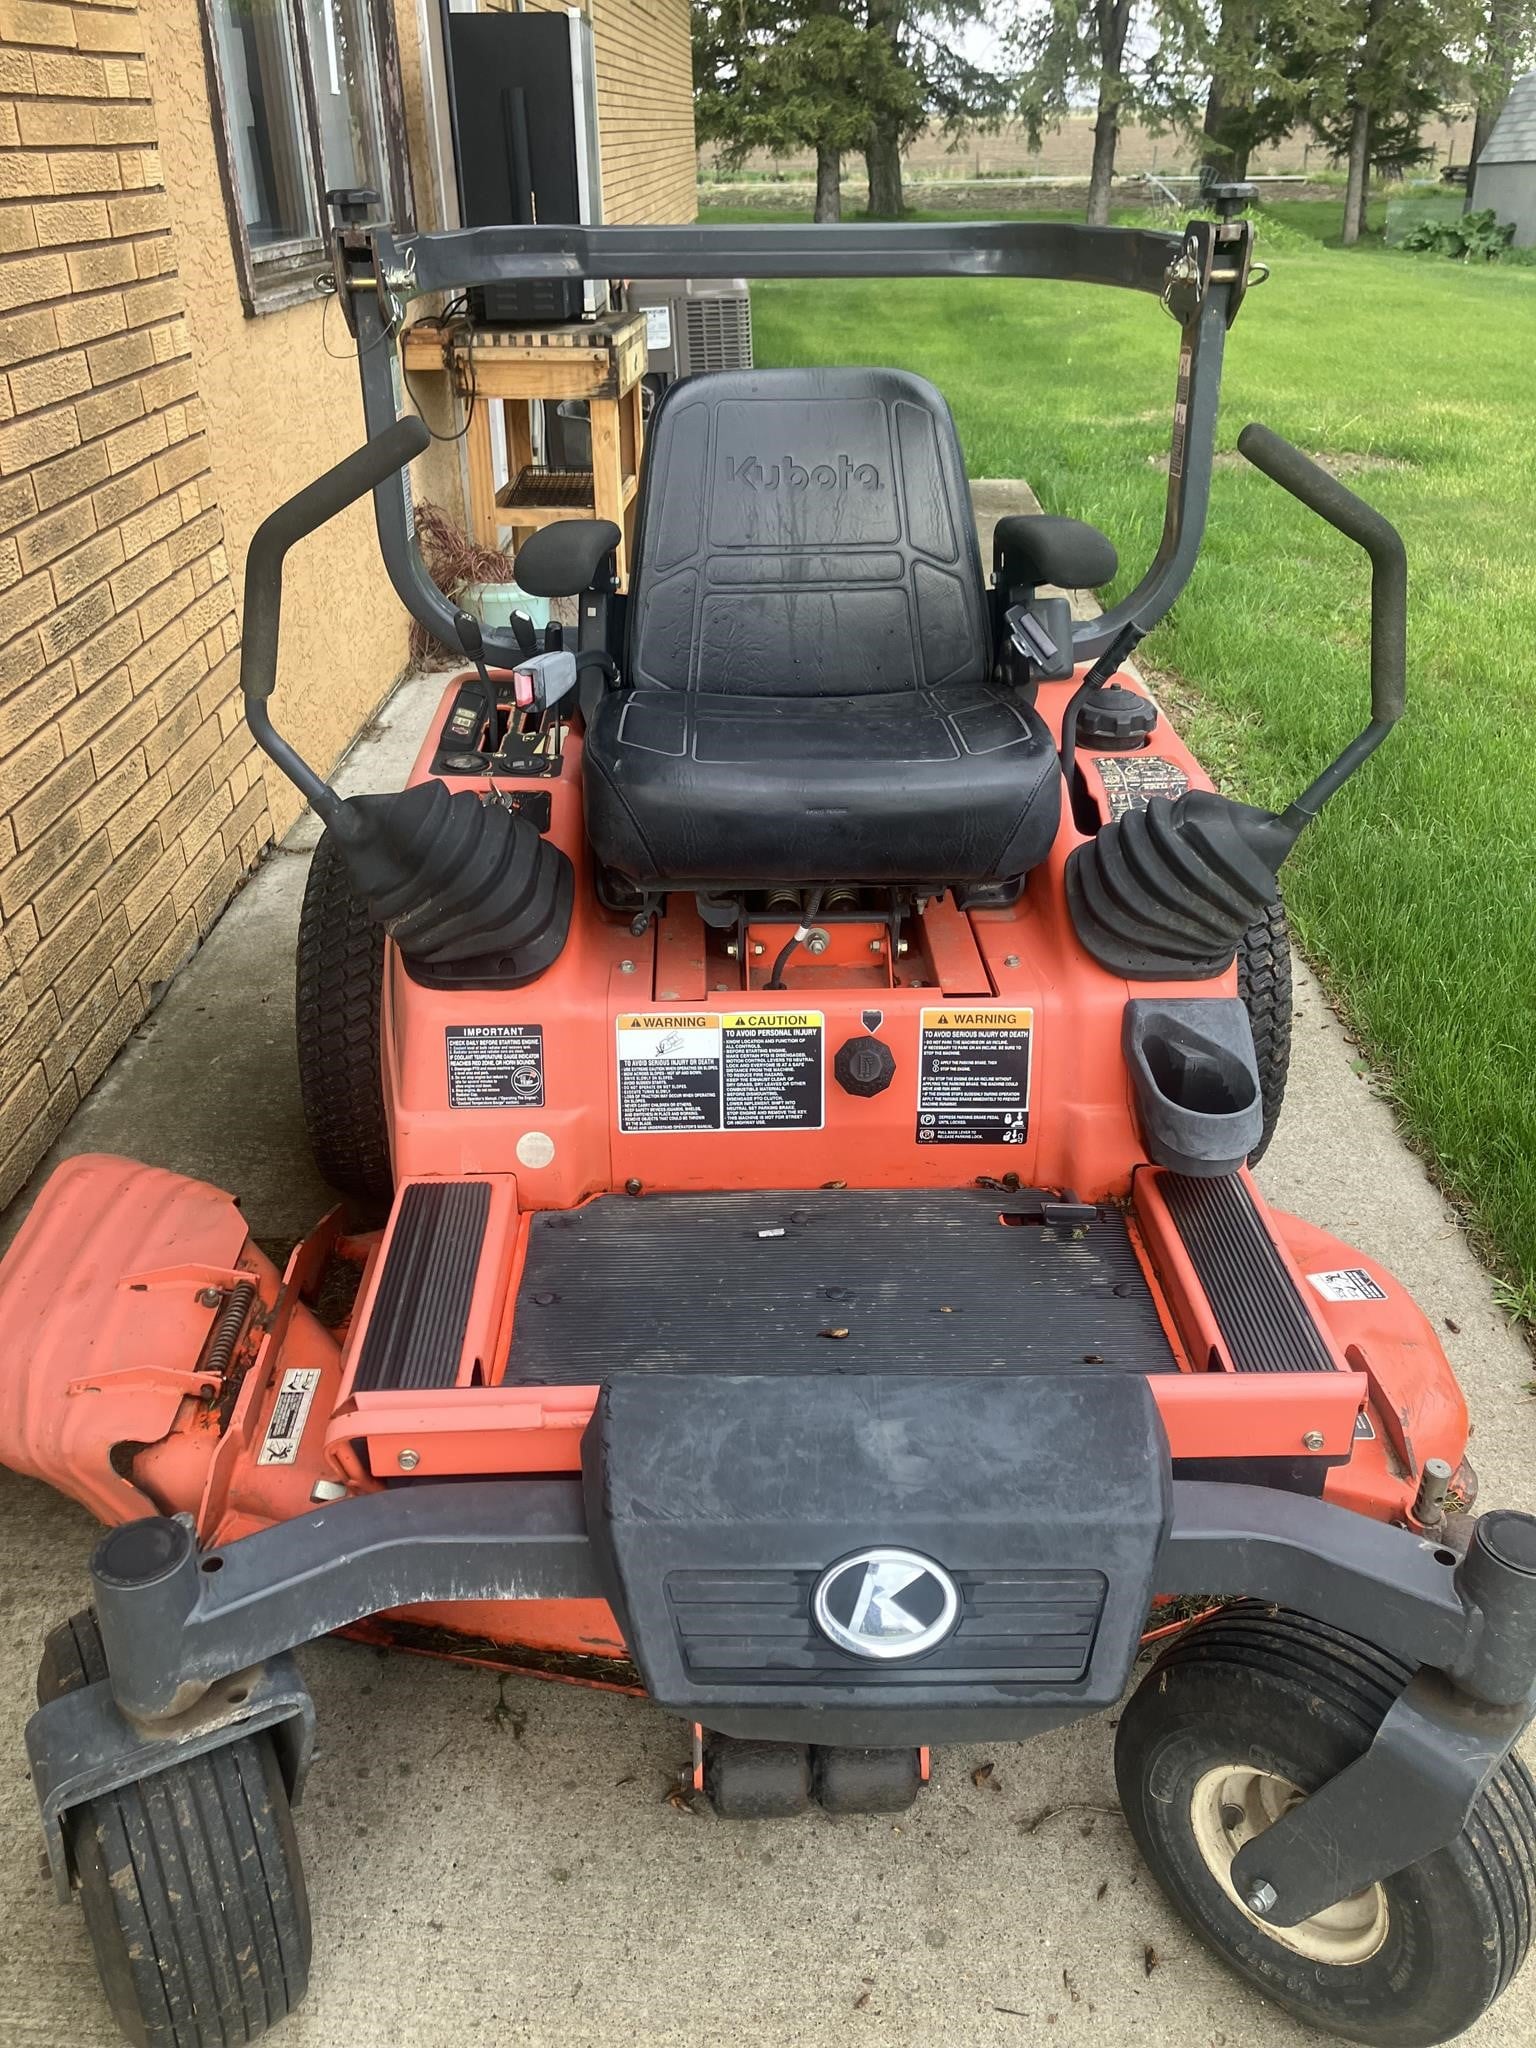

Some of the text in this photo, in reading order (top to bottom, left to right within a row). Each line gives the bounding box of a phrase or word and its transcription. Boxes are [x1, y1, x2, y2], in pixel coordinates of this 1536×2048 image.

[726, 454, 880, 492] Kubota
[644, 1017, 705, 1027] WARNING
[748, 1016, 806, 1026] CAUTION
[954, 1014, 1016, 1023] WARNING
[464, 1028, 523, 1036] IMPORTANT
